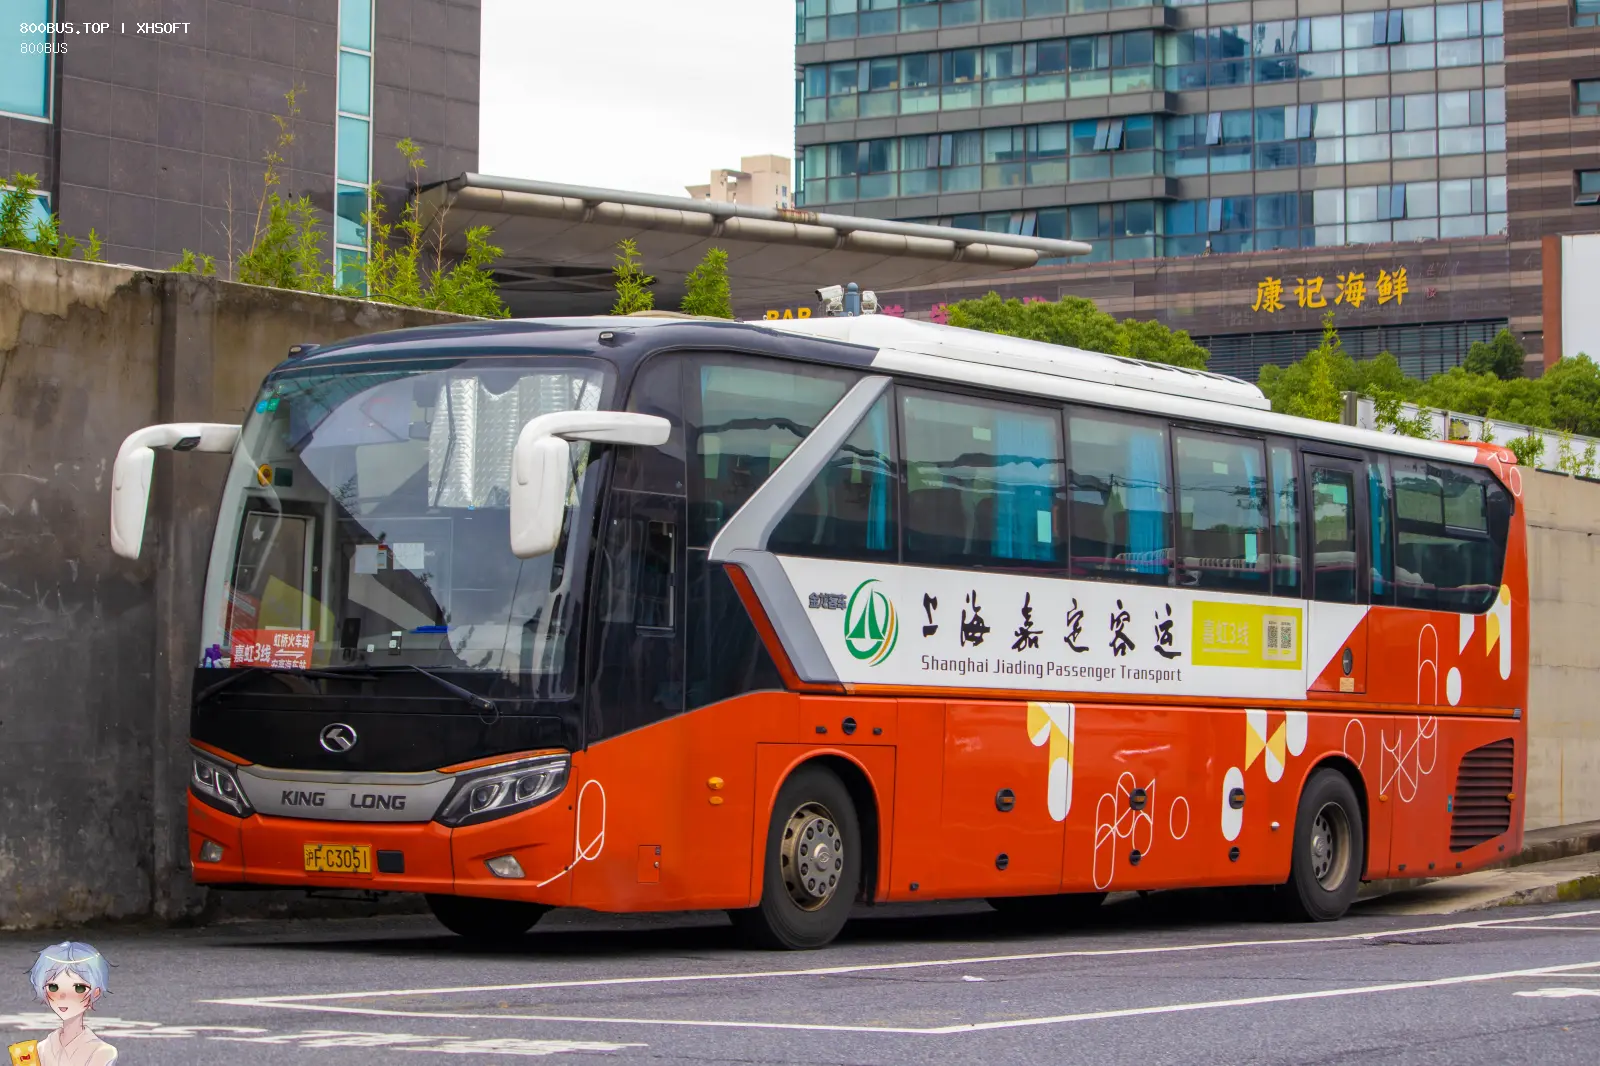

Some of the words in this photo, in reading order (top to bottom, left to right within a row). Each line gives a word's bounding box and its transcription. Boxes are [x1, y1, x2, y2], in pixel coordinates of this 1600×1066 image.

[1251, 267, 1409, 313] 康记海鲜
[922, 589, 1182, 660] 上海嘉定客运
[233, 643, 272, 663] 嘉虹3线
[273, 633, 311, 649] 虹桥火车站
[921, 654, 988, 676] Shanghai
[993, 658, 1043, 679] Jiading
[1046, 661, 1116, 682] Passenger
[1119, 664, 1182, 684] Transport
[281, 790, 326, 807] KING
[350, 793, 407, 811] LONG
